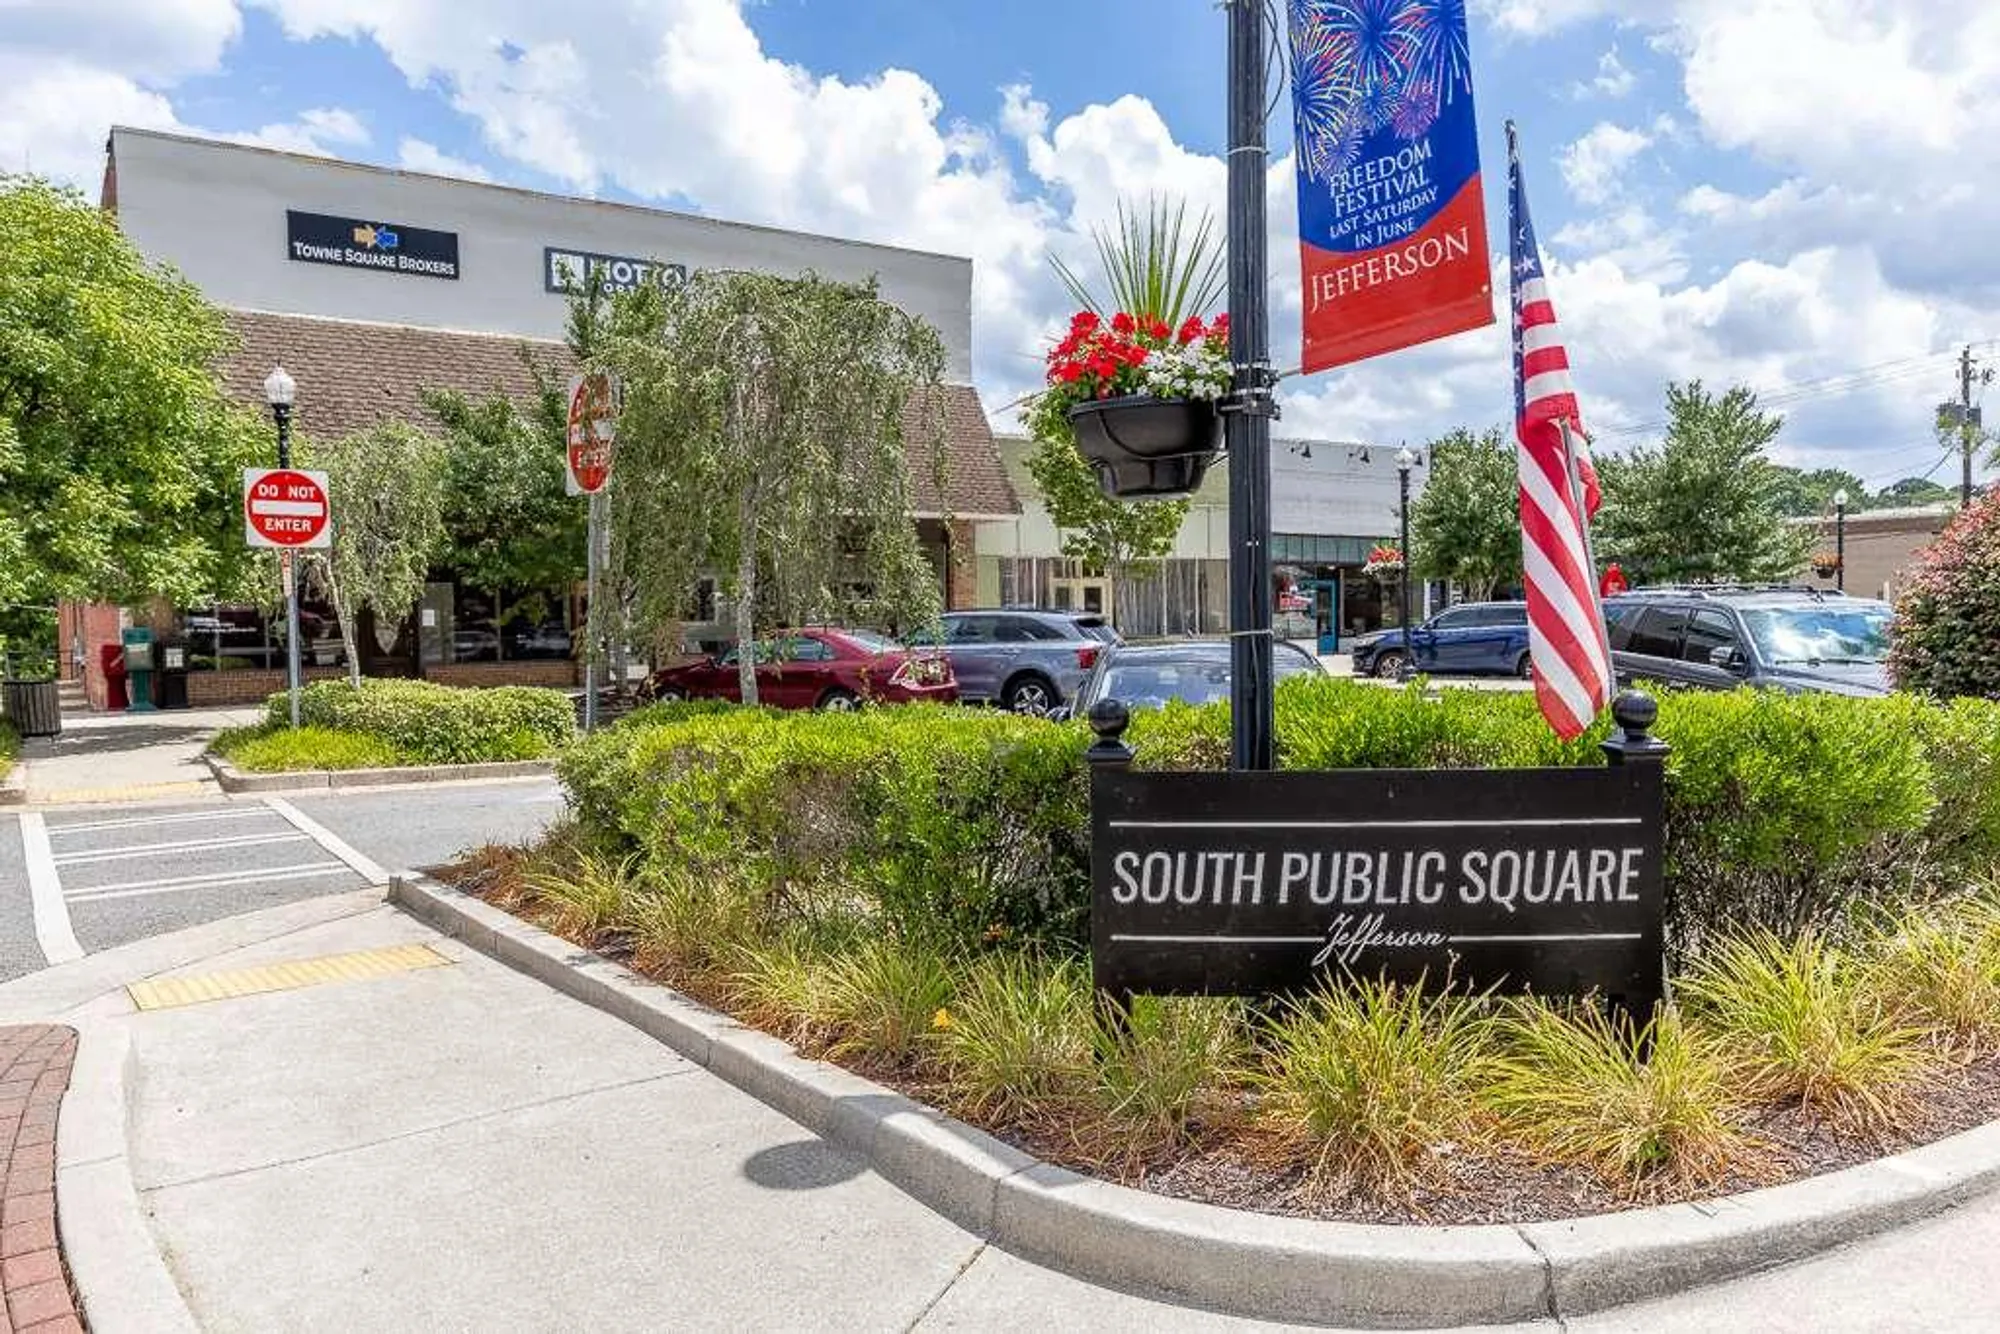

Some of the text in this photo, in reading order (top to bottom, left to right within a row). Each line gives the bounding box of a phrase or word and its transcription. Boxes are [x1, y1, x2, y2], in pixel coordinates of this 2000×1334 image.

[1329, 139, 1433, 198] FREEDOM
[1335, 165, 1430, 218] FESTIVAL
[1329, 185, 1439, 240] LAST SATURDAY
[1355, 217, 1417, 249] IN JUNE
[293, 242, 455, 275] TOWNE SQUARE BROKERS
[1310, 226, 1469, 314] JEFFERSON
[258, 484, 316, 499] DO NOT
[264, 517, 312, 532] ENTER
[1111, 848, 1644, 912] SOUTH PUBLIC SQUARE
[1311, 912, 1448, 967] Jefferson
